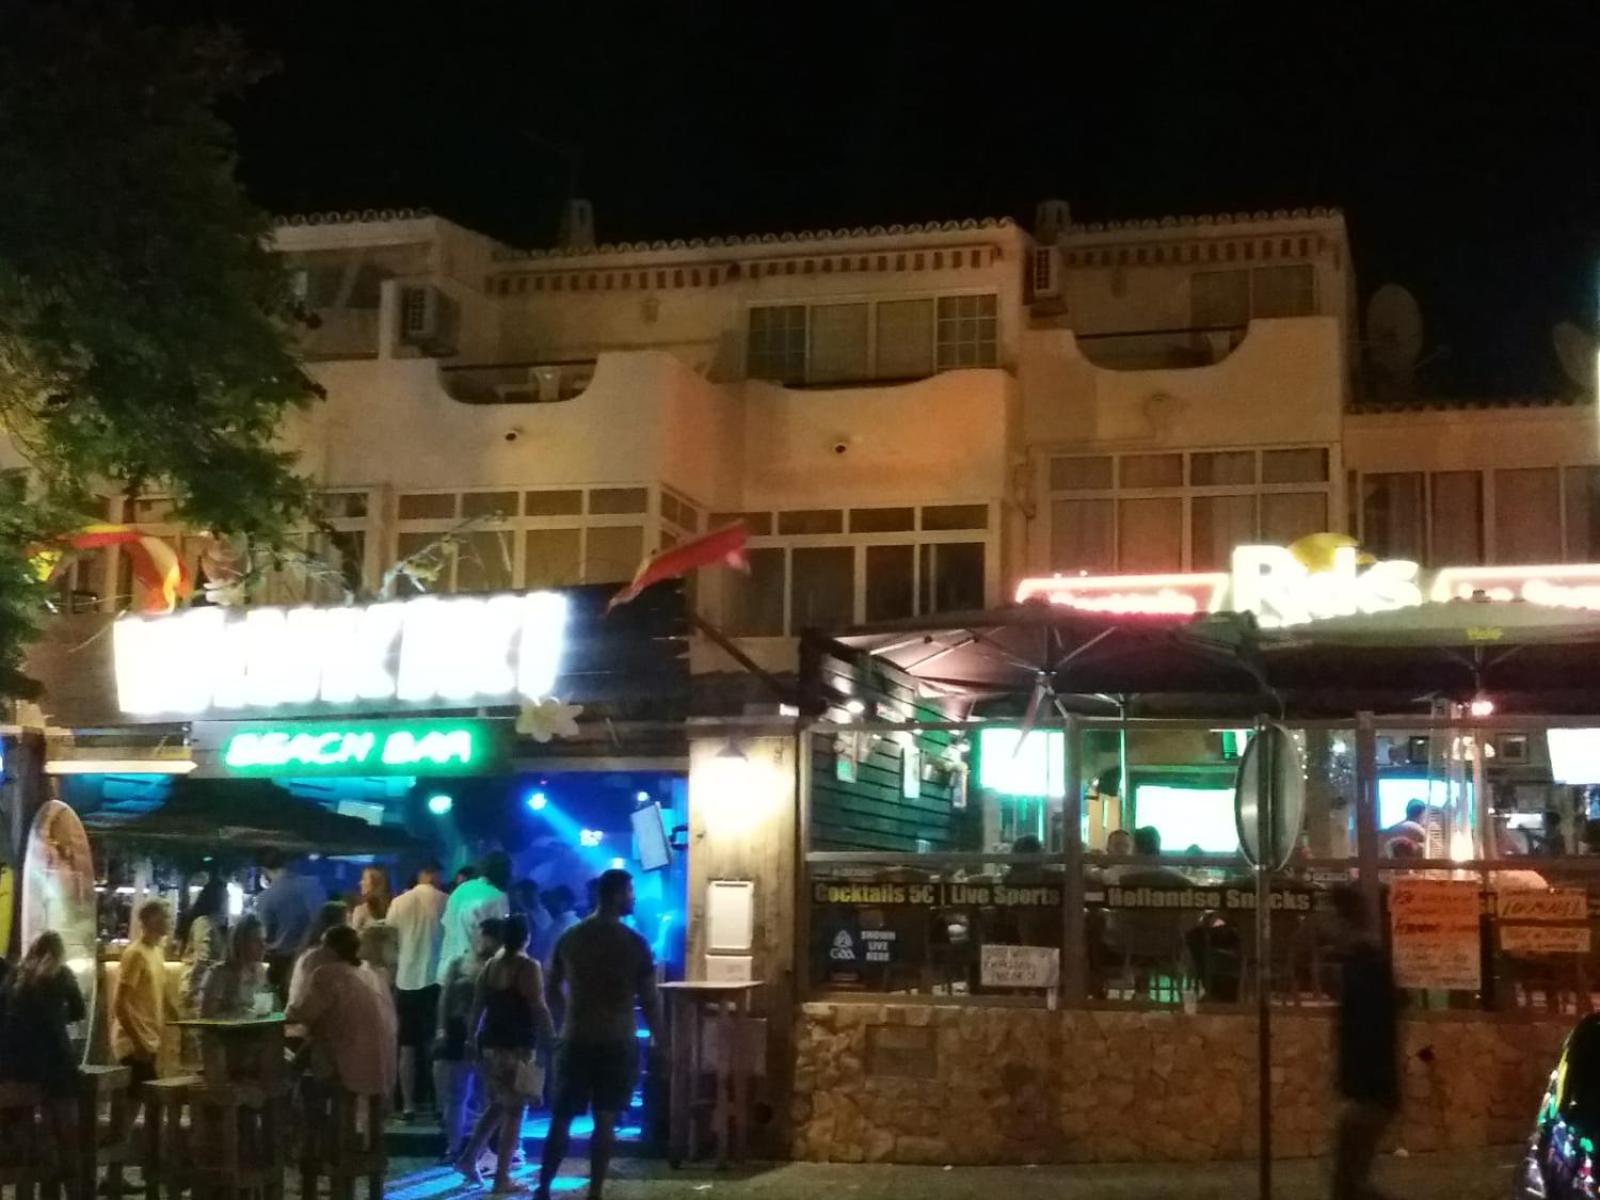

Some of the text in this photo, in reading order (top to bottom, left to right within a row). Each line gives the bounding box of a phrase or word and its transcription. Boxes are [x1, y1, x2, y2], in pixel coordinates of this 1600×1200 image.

[226, 730, 471, 767] BEACH BAR
[814, 882, 905, 904] Cocktails
[951, 884, 989, 905] Live
[993, 885, 1060, 906] Sports
[1107, 886, 1311, 911] Hollandse Sncks
